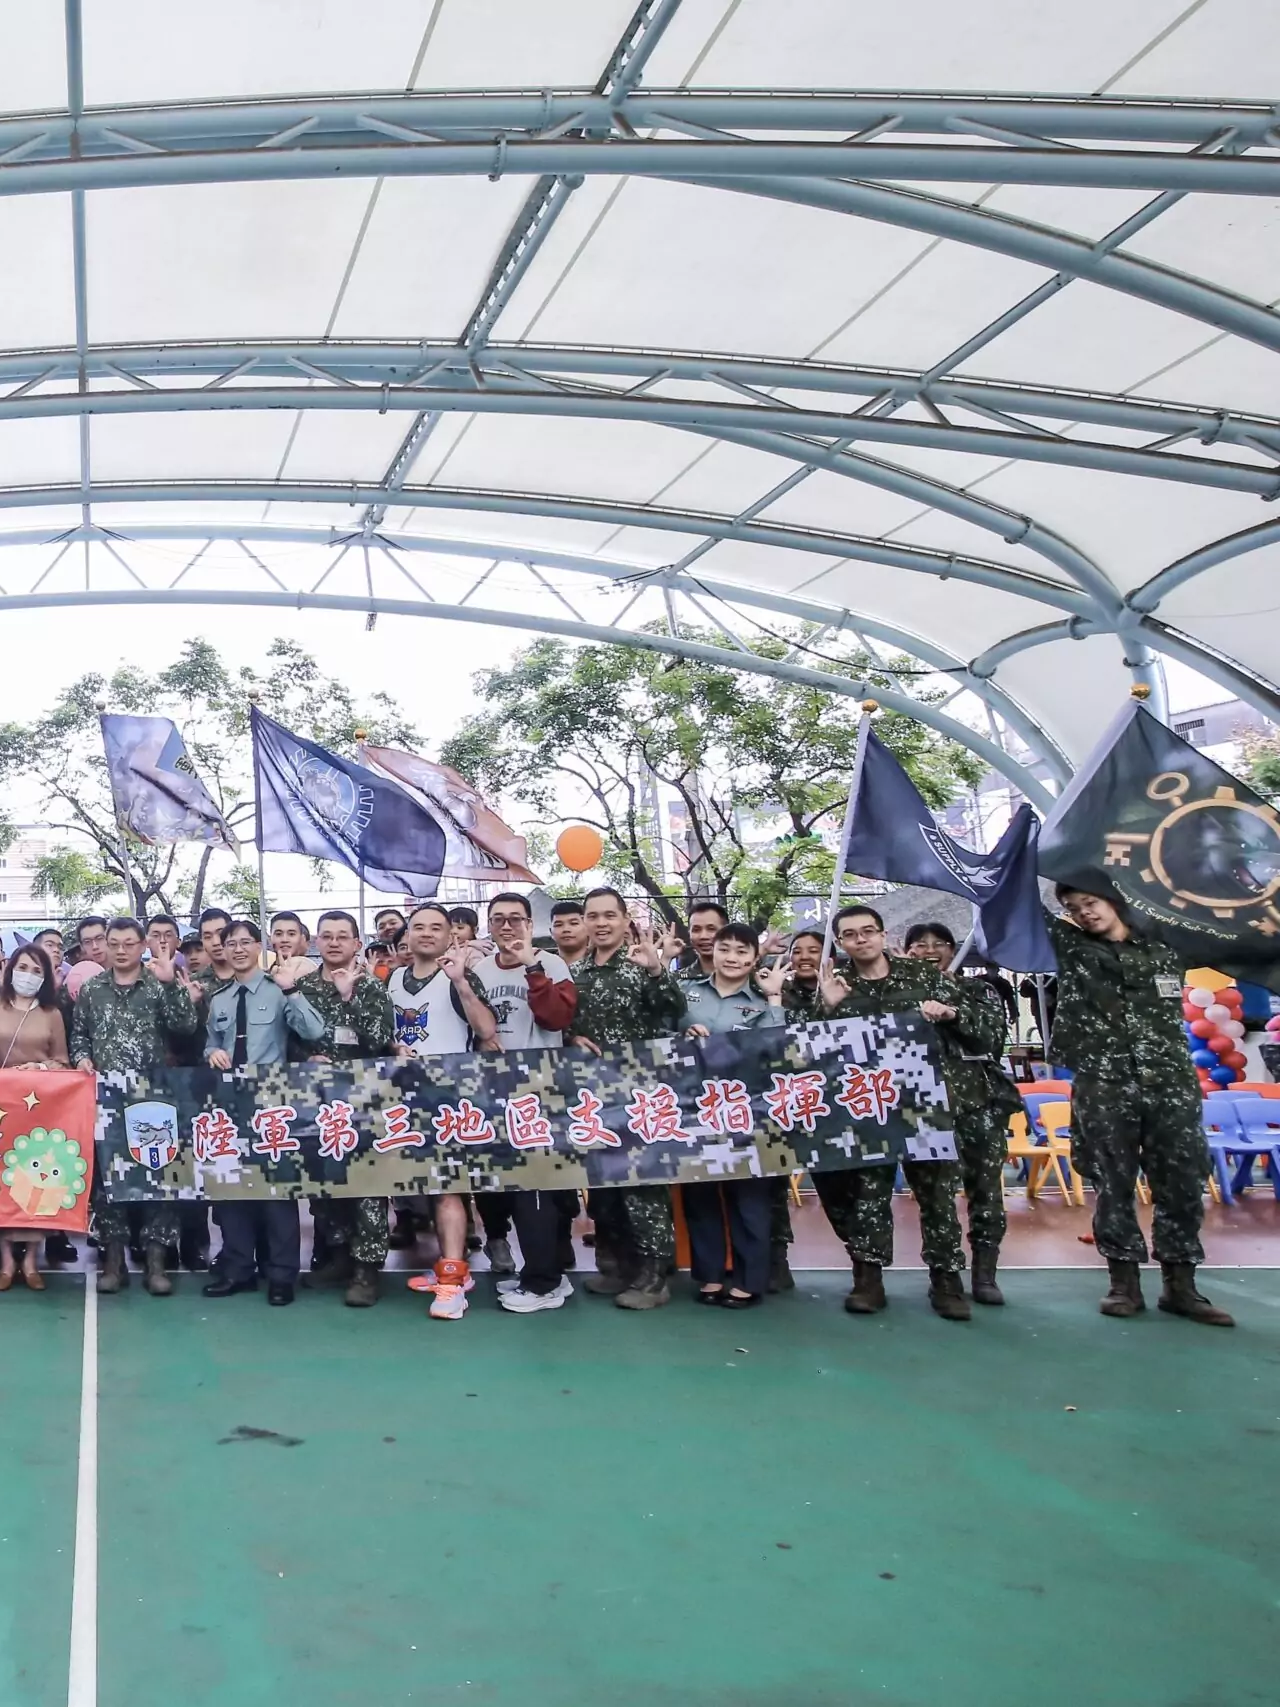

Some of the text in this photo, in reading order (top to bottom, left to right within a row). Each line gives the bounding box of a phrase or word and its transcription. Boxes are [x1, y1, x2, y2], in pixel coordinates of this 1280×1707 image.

[933, 840, 963, 875] SUPPLY
[1133, 899, 1145, 911] Li
[1145, 907, 1181, 927] Supply
[1180, 920, 1239, 941] Sub-Depot
[191, 1062, 900, 1164] 陸軍第三地區支援指揮部
[152, 1151, 158, 1163] 3
